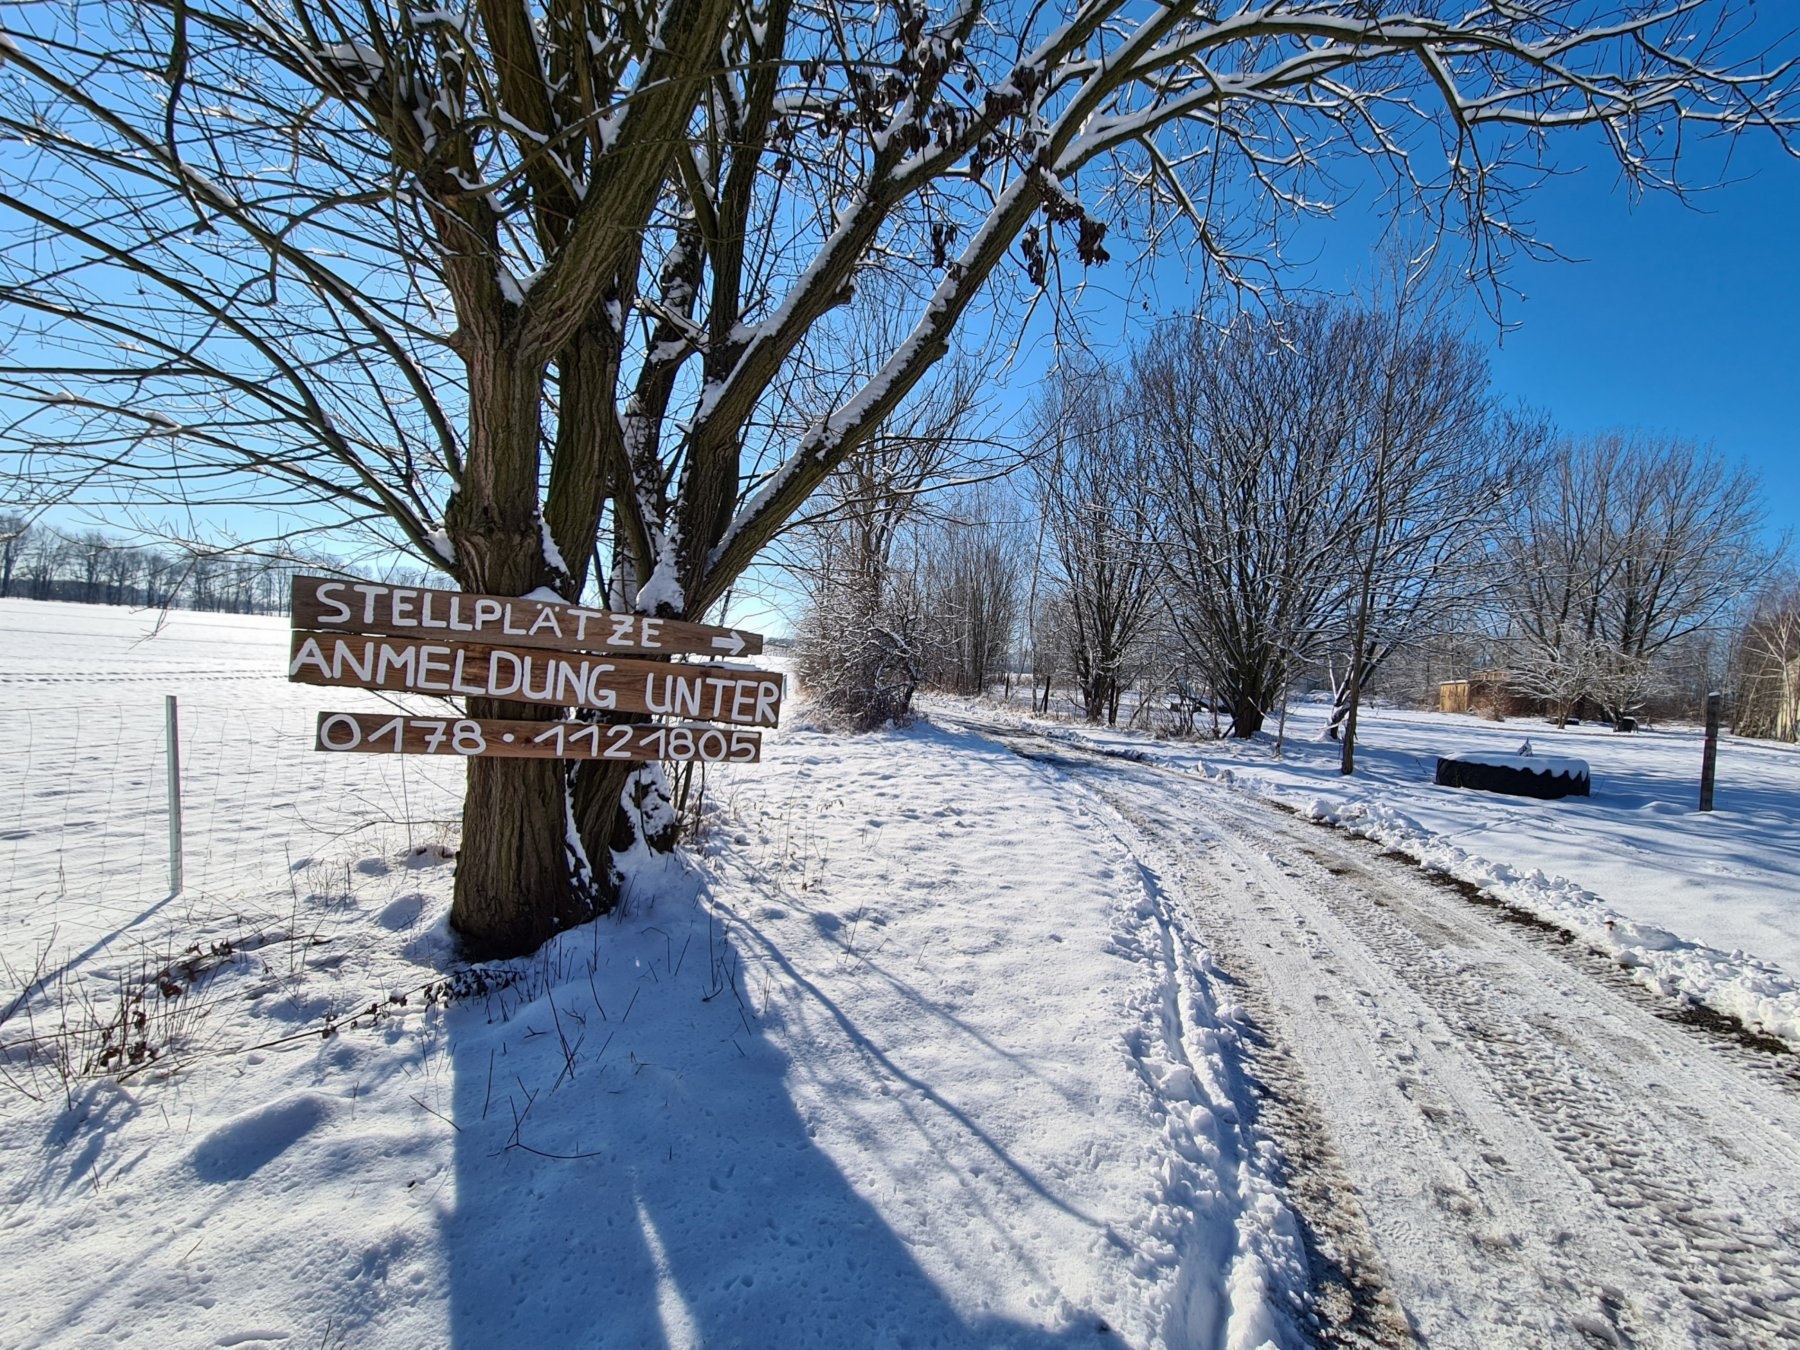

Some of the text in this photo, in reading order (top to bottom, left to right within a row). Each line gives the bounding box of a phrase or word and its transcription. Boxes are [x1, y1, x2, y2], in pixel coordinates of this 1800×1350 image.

[316, 582, 664, 648] STELLPLÄTZE
[289, 637, 780, 724] ANMELDUNG UNTER
[320, 713, 487, 756] 0178
[534, 723, 758, 763] 1121805
